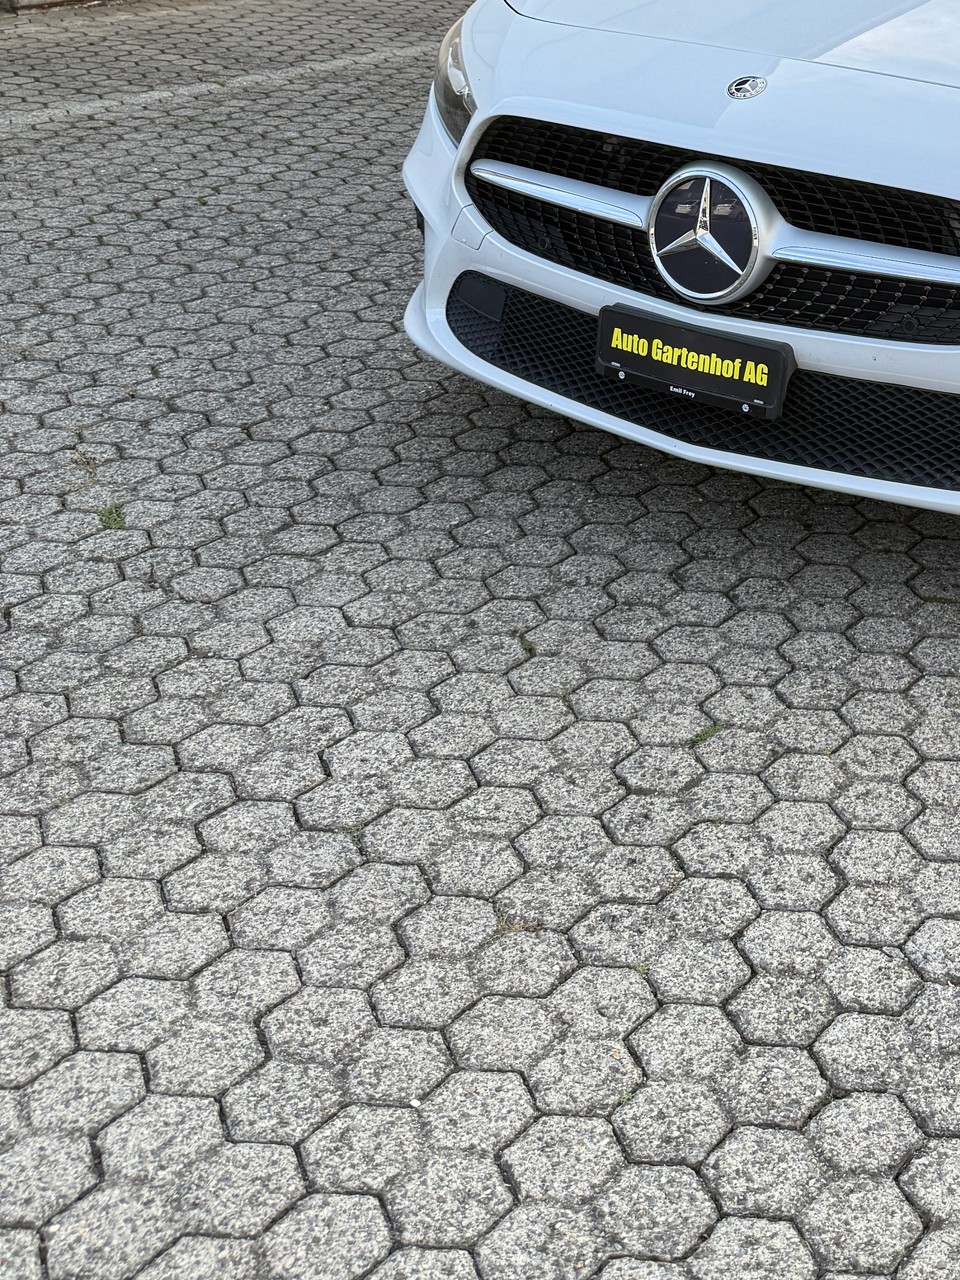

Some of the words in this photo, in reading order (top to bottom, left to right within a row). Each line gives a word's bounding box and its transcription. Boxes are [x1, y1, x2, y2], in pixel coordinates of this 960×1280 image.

[611, 327, 648, 357] Auto
[651, 338, 741, 380] Gartenhof
[743, 360, 769, 387] AG
[669, 385, 682, 394] Emil
[683, 389, 695, 399] Frey
